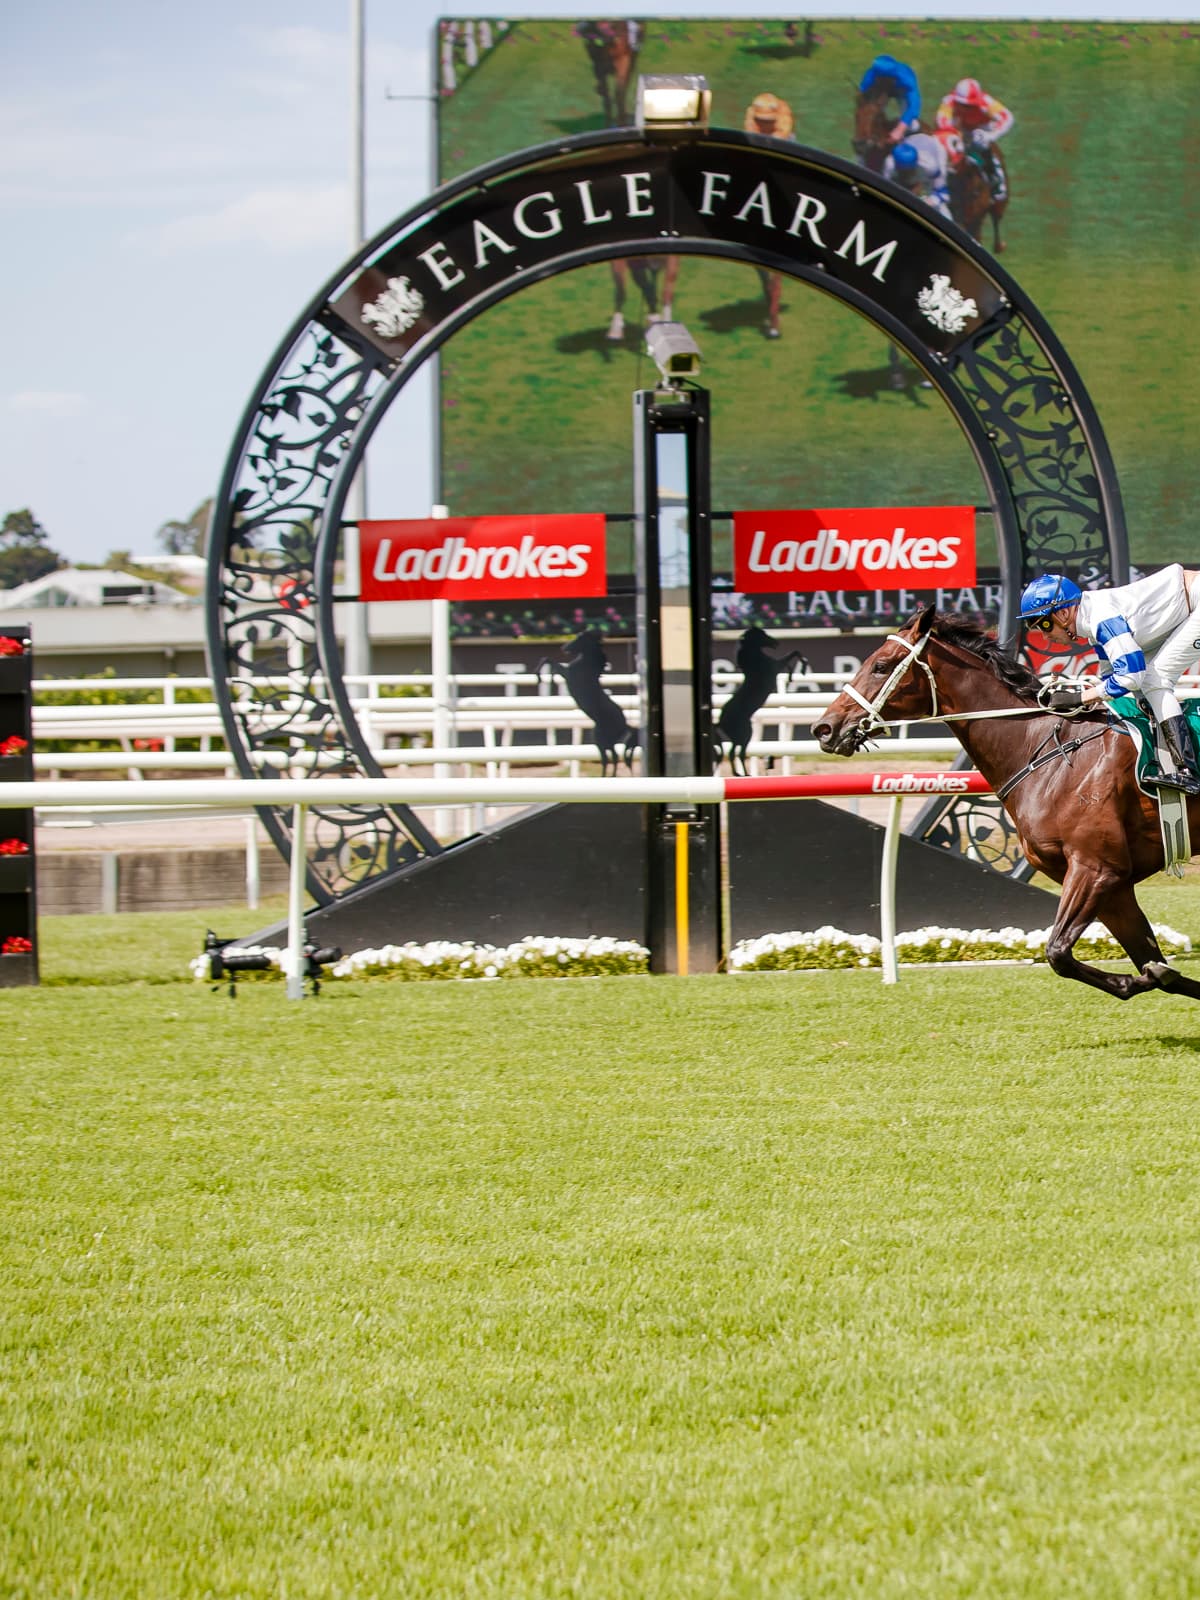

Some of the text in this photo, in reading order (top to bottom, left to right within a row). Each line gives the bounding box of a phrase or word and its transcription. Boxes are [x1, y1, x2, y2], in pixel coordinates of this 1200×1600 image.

[417, 172, 898, 291] EAGLE FARM
[372, 535, 592, 583] Ladbrokes
[748, 527, 961, 573] Ladbrokes
[871, 773, 971, 793] Ladbrokes
